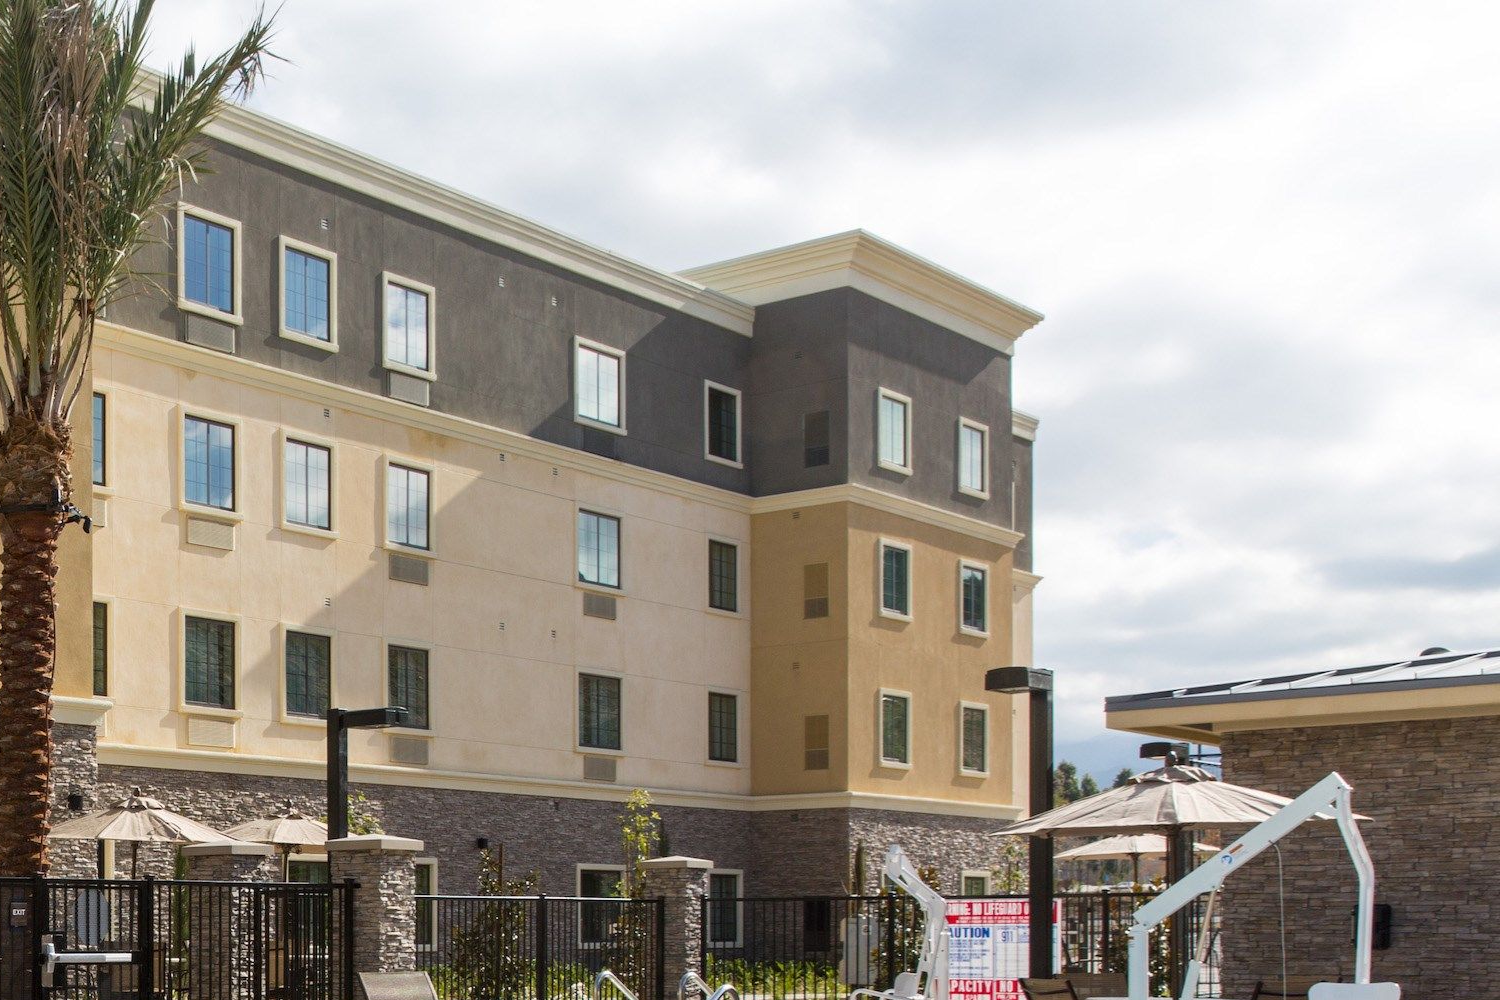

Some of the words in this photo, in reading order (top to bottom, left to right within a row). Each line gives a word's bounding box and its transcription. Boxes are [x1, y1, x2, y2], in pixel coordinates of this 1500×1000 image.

[949, 927, 990, 938] AUTION
[950, 980, 992, 993] PACITY
[1000, 980, 1013, 993] NO
